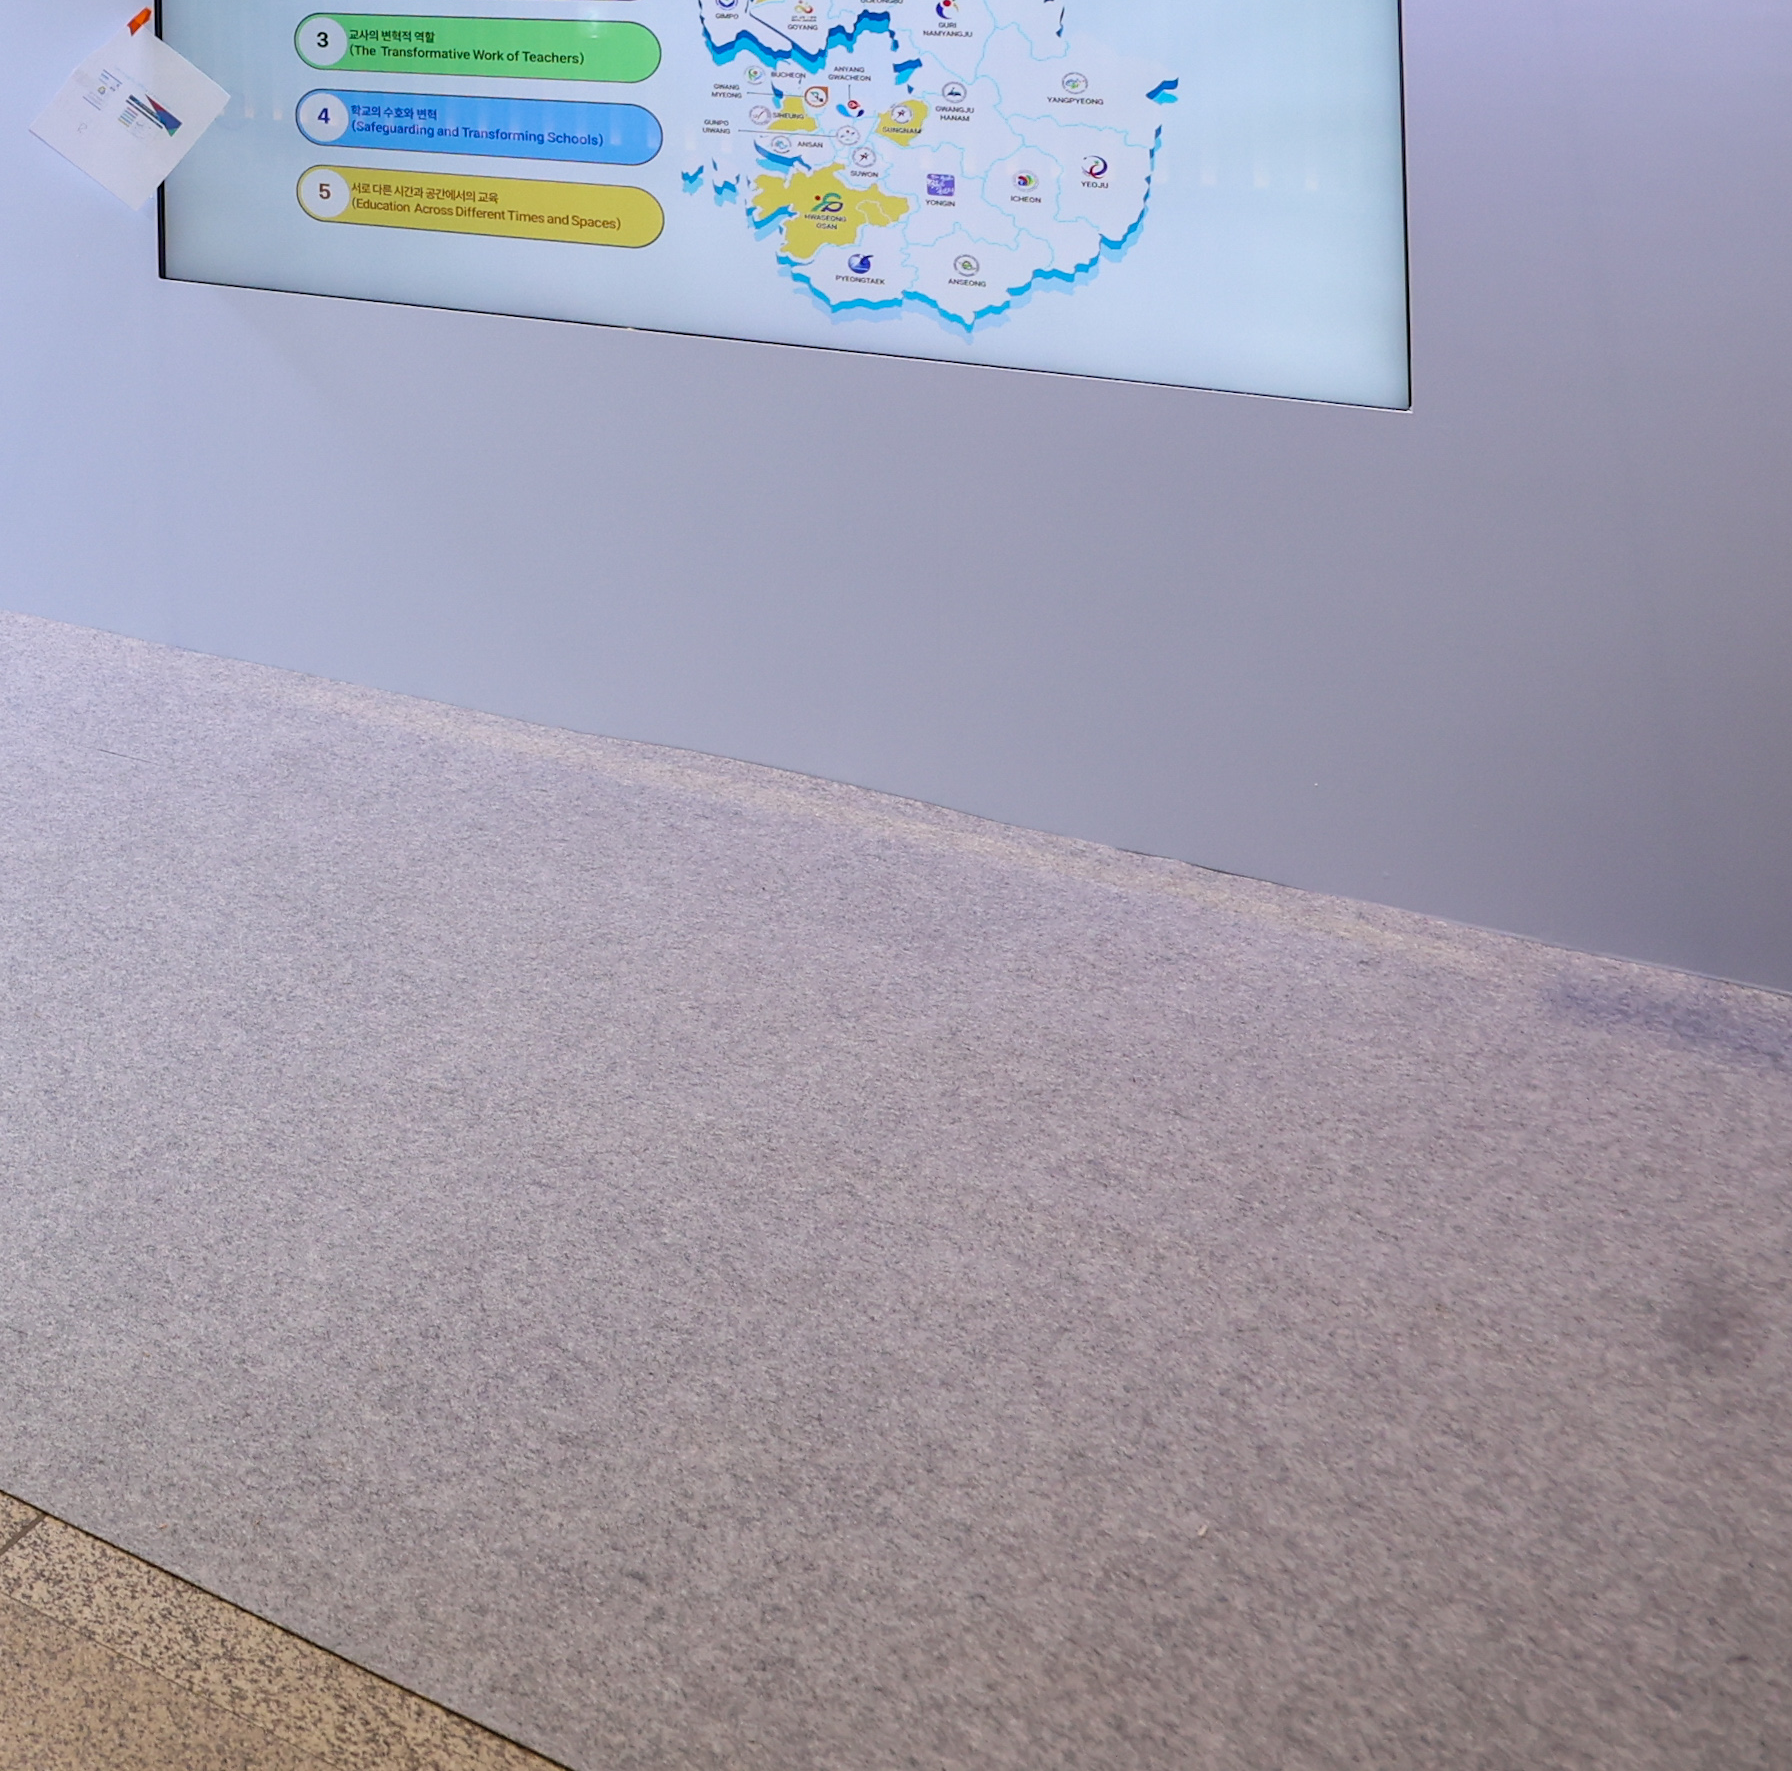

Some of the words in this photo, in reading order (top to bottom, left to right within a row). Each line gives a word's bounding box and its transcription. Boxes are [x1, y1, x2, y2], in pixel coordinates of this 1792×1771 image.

[316, 31, 329, 48] 3
[349, 44, 377, 56] (The
[380, 46, 471, 60] Transformative
[472, 49, 504, 61] Work
[506, 50, 520, 62] of
[522, 51, 585, 65] Teachers)
[317, 107, 330, 124] 4
[351, 121, 435, 138] (Safeguarding
[437, 127, 459, 138] and
[463, 128, 545, 145] Transforming
[548, 133, 605, 147] Schools)
[319, 183, 331, 200] 5
[351, 197, 411, 212] (Education
[414, 203, 454, 216] Across
[455, 206, 506, 220] Different
[507, 209, 545, 224] Times
[546, 214, 570, 226] and
[571, 215, 621, 231] Spaces)
